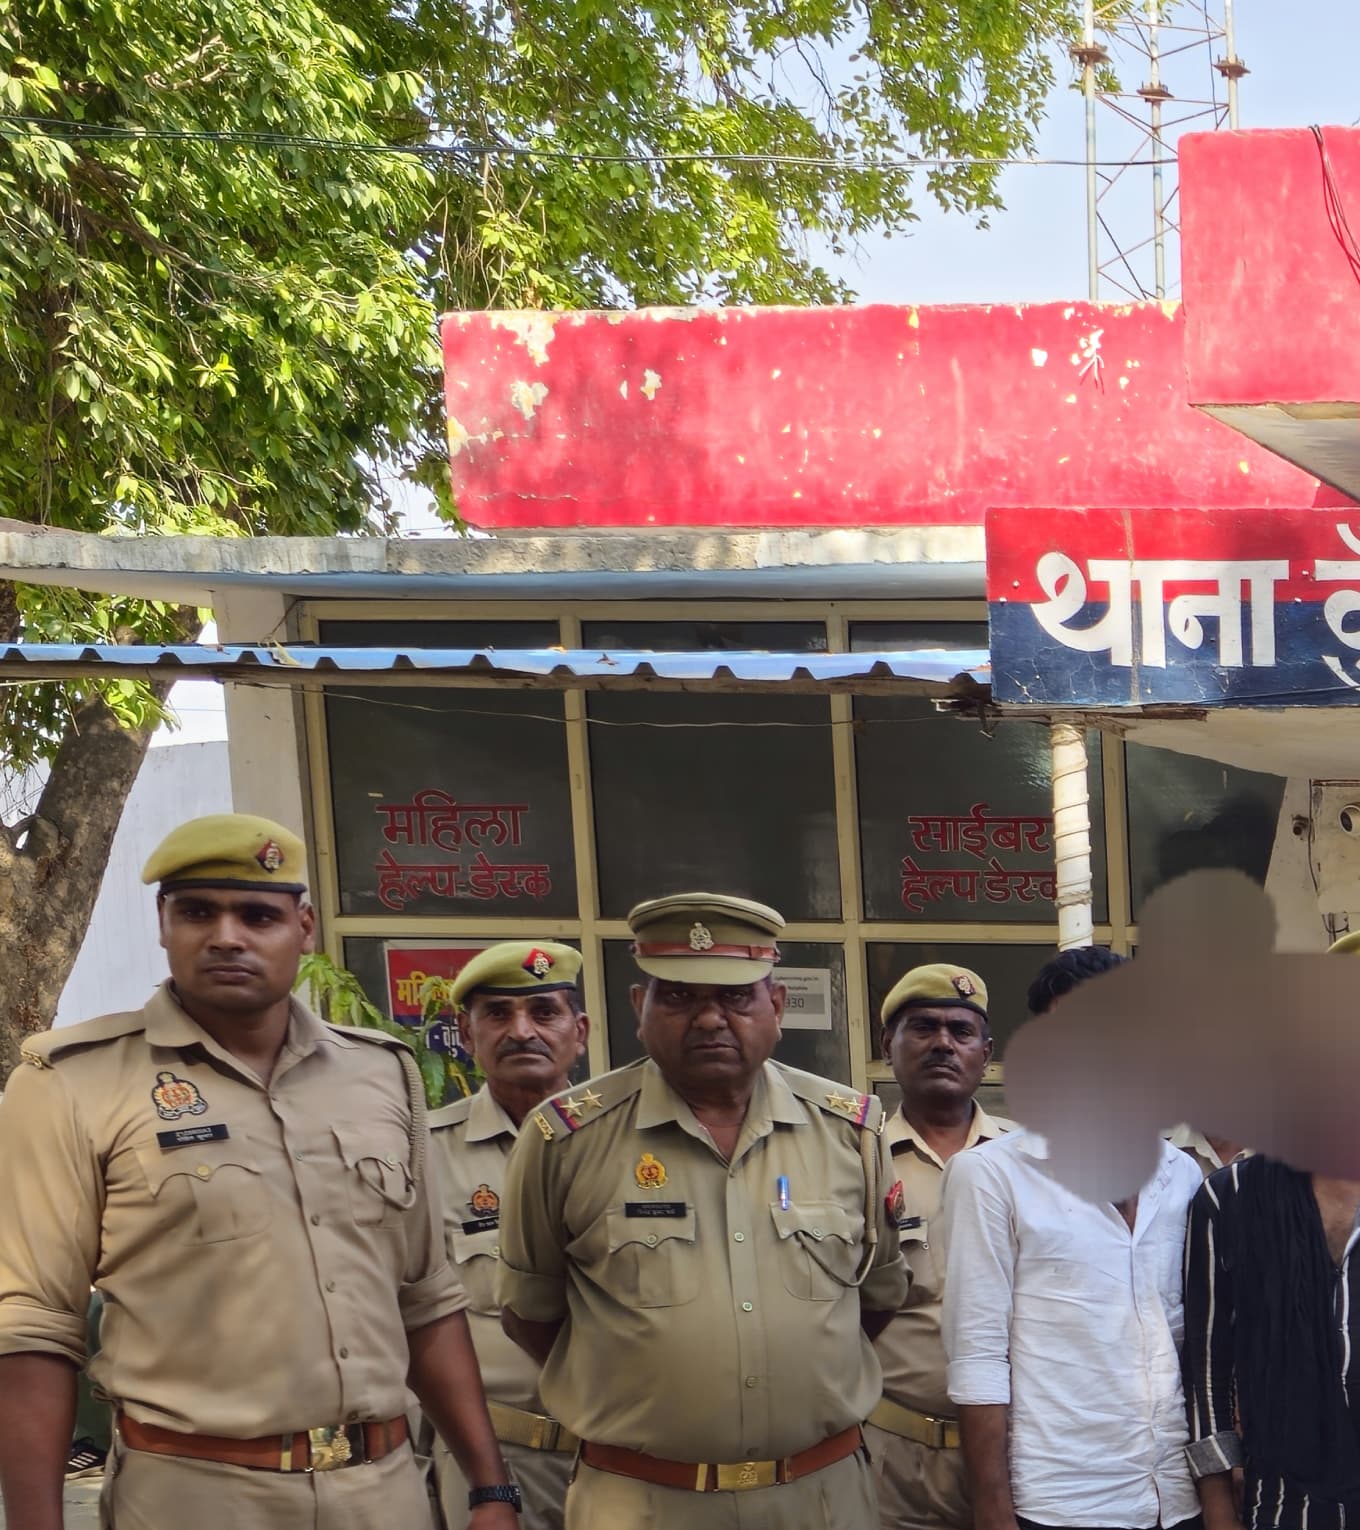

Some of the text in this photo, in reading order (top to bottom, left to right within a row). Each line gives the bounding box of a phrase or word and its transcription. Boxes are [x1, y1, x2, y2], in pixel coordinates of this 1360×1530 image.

[1030, 551, 1290, 668] थाना
[376, 788, 528, 854] महिला
[908, 801, 1054, 861] साईबर
